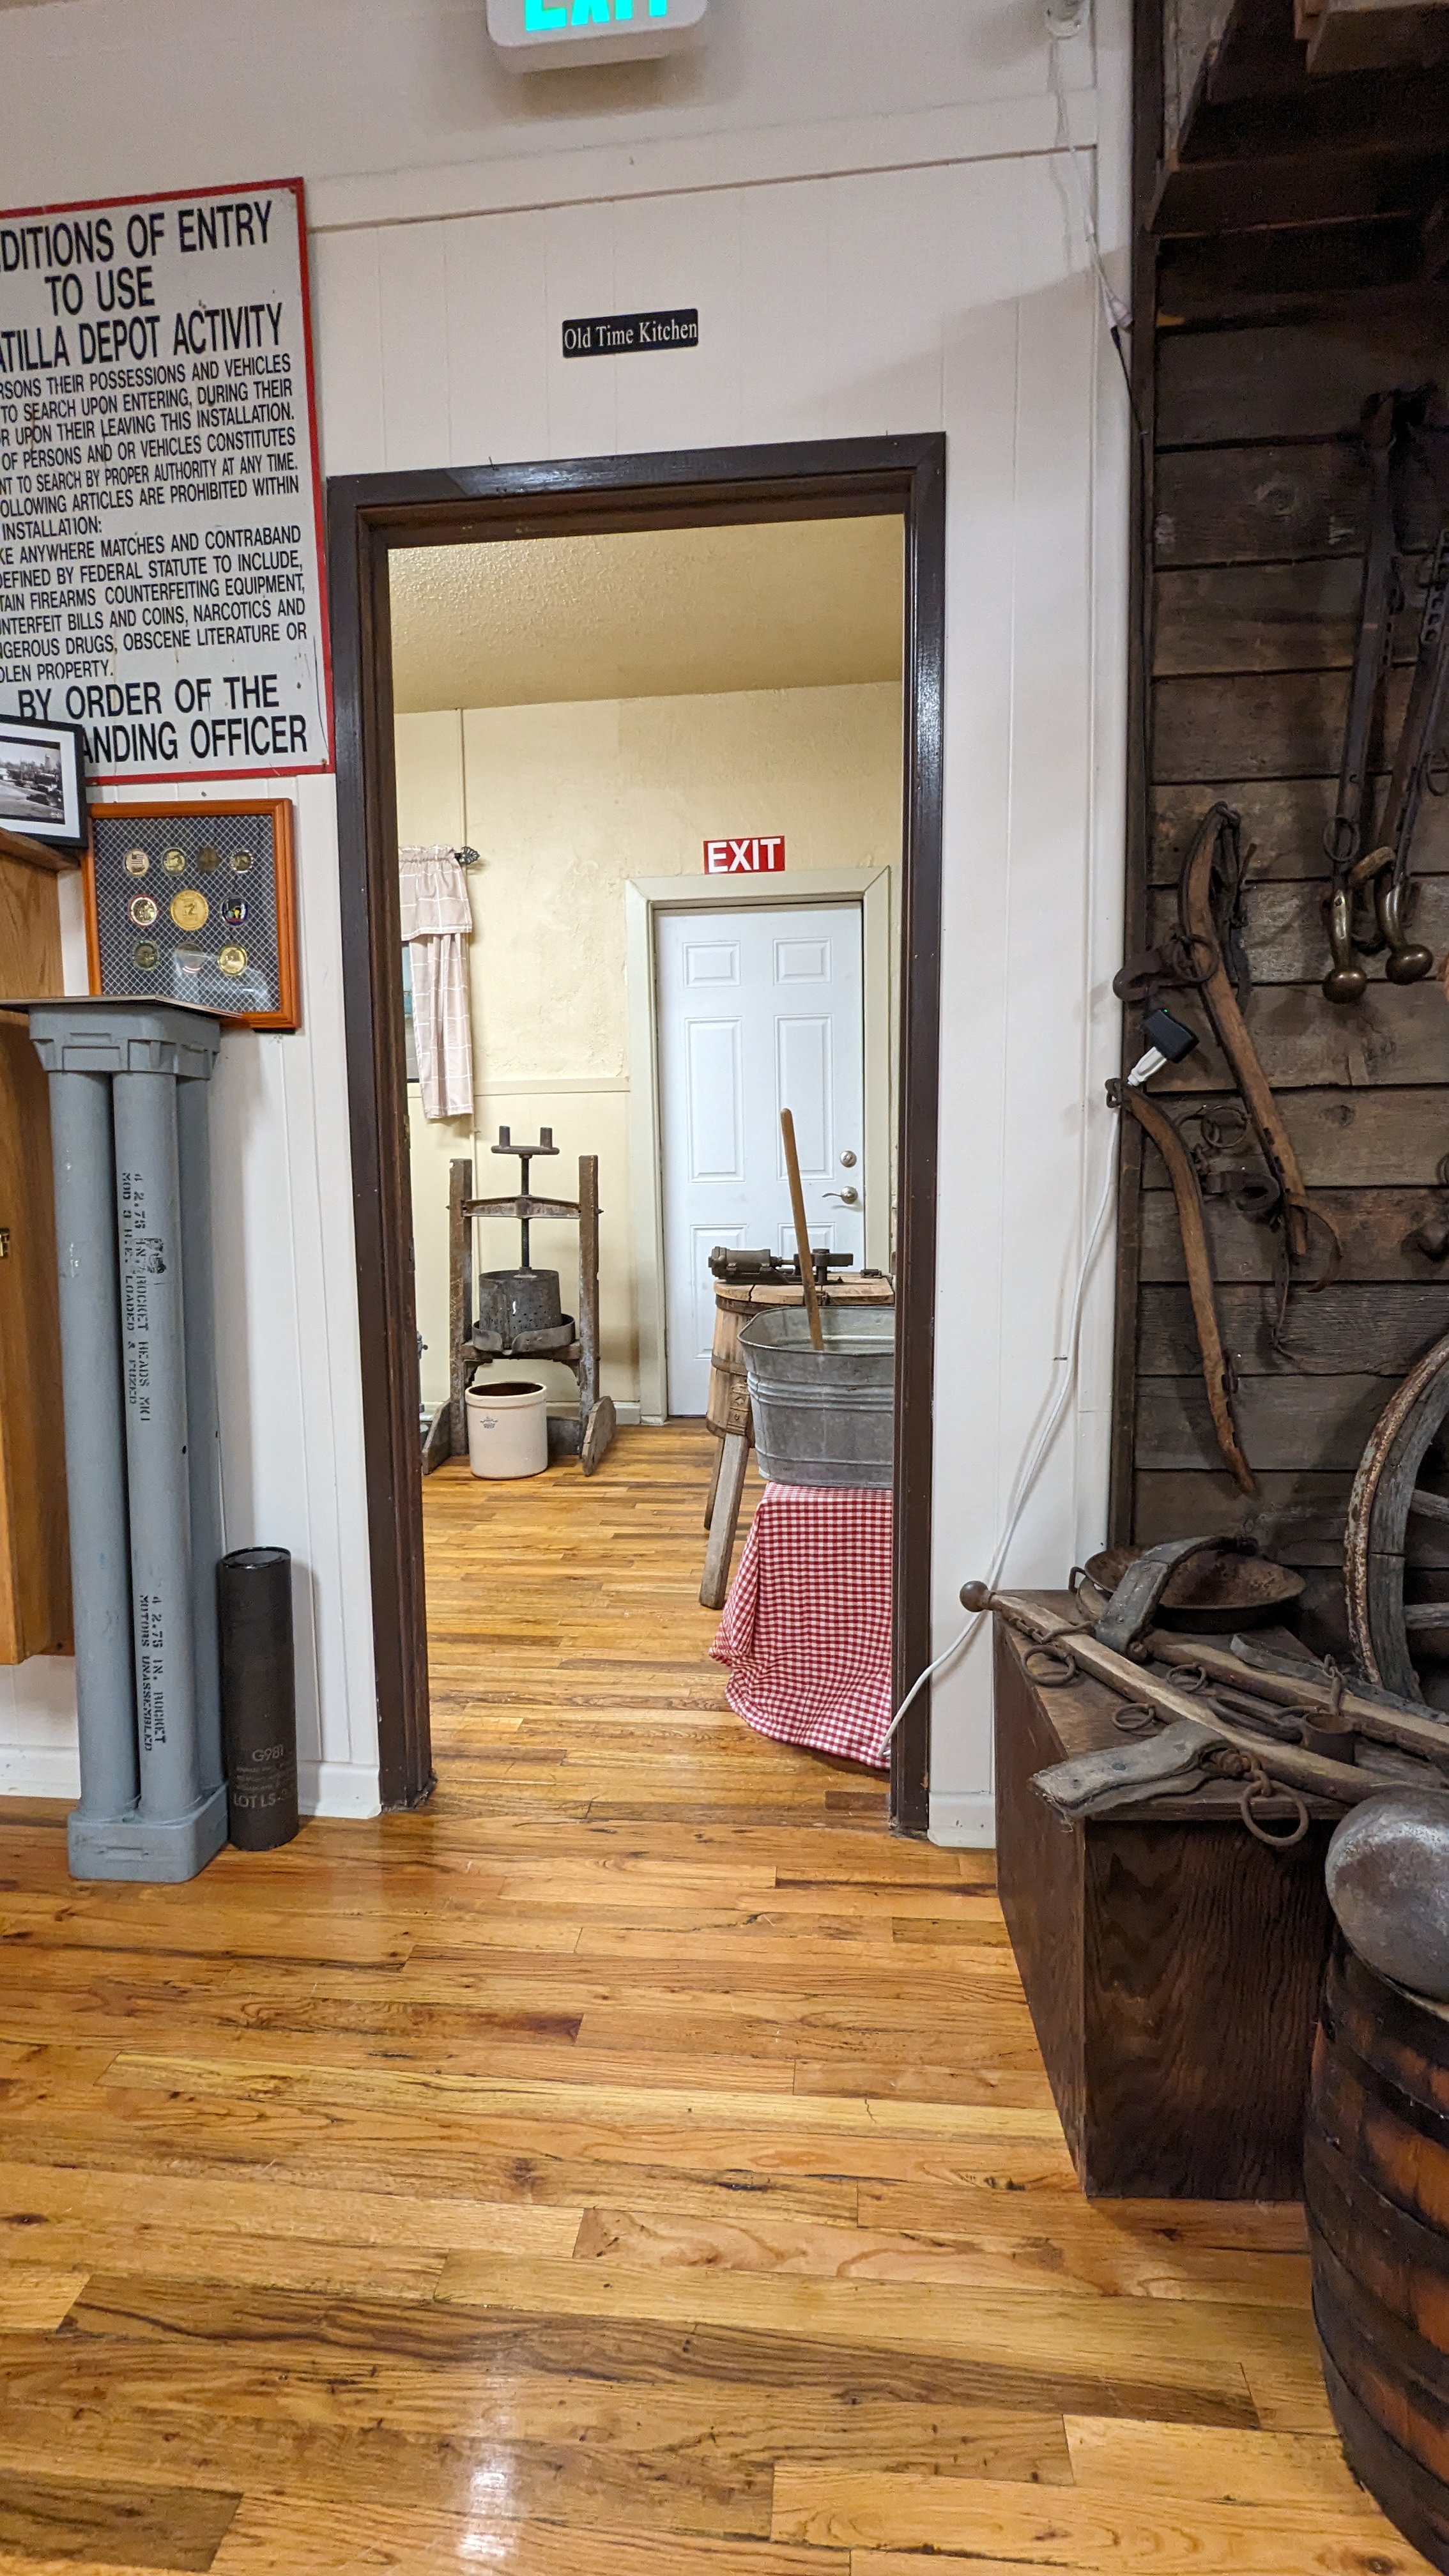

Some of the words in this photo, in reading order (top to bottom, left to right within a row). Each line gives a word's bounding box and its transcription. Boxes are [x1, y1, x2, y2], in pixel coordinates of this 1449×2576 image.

[0, 218, 114, 272] DITIONS
[126, 212, 164, 259] OF
[178, 200, 272, 253] ENTRY
[44, 273, 83, 316] TO
[95, 265, 155, 312] USE
[78, 315, 160, 365] DEPOT
[173, 302, 283, 356] ACTIVITY
[564, 326, 591, 349] Old
[595, 325, 634, 347] Time
[639, 319, 697, 343] Kitchen
[46, 374, 84, 395] THEIR
[89, 363, 186, 391] POSSESSIONS
[192, 361, 219, 381] AND
[224, 353, 291, 378] VEHICLES
[0, 404, 18, 424] TO
[24, 399, 76, 422] SEARCH
[80, 395, 118, 416] UPON
[197, 381, 249, 405] DURING
[253, 378, 293, 399] THEIR
[15, 425, 52, 445] UPON
[56, 420, 95, 441] THEIR
[100, 415, 155, 439] LEAVING
[160, 411, 191, 431] THIS
[197, 402, 294, 428] INSTALLATION.
[1, 452, 18, 471] OF
[23, 446, 82, 469] PERSONS
[87, 441, 112, 463] AND
[118, 441, 136, 460] OR
[140, 435, 202, 457] VEHICLES
[207, 426, 295, 452] CONSTITUTES
[16, 475, 32, 493] TO
[36, 471, 81, 492] SEARCH
[86, 469, 100, 487] BY
[105, 464, 149, 486] PROPER
[154, 459, 217, 482] AUTHORITY
[222, 457, 234, 476] AT
[240, 454, 262, 475] ANY
[266, 452, 298, 472] TIME.
[0, 494, 67, 518] OLLOWING
[72, 489, 134, 512] ARTICLES
[139, 486, 165, 507] ARE
[170, 480, 247, 503] PROHIBITED
[252, 475, 299, 496] WITHIN
[2, 516, 102, 540] INSTALLATION:
[20, 540, 95, 564] ANYWHERE
[100, 535, 165, 558] MATCHES
[171, 533, 199, 553] AND
[204, 525, 302, 549] CONTRABAND
[57, 566, 73, 585] BY
[80, 562, 143, 583] FEDERAL
[148, 556, 208, 578] STATUTE
[213, 555, 232, 573] TO
[238, 549, 302, 572] INCLUDE,
[30, 588, 96, 610] FIREARMS
[105, 579, 220, 605] COUNTERFEITING
[225, 573, 305, 596] EQUIPMENT,
[67, 611, 103, 631] BILLS
[109, 610, 136, 628] AND
[142, 606, 188, 625] COINS,
[193, 599, 272, 622] NARCOTICS
[278, 597, 305, 617] AND
[123, 629, 191, 651] OBSCENE
[197, 624, 280, 646] LITERATURE
[286, 622, 307, 640] OR
[37, 659, 113, 680] PROPERTY.
[18, 688, 52, 721] BY
[66, 681, 162, 720] ORDER
[174, 678, 211, 714] OF
[223, 673, 280, 709] THE
[190, 714, 307, 758] OFFICER
[707, 838, 781, 873] EXIT
[136, 1276, 148, 1331] ROCKET
[139, 1342, 149, 1386] HEADS
[151, 1613, 163, 1648] 2.75
[153, 1659, 163, 1680] IN.
